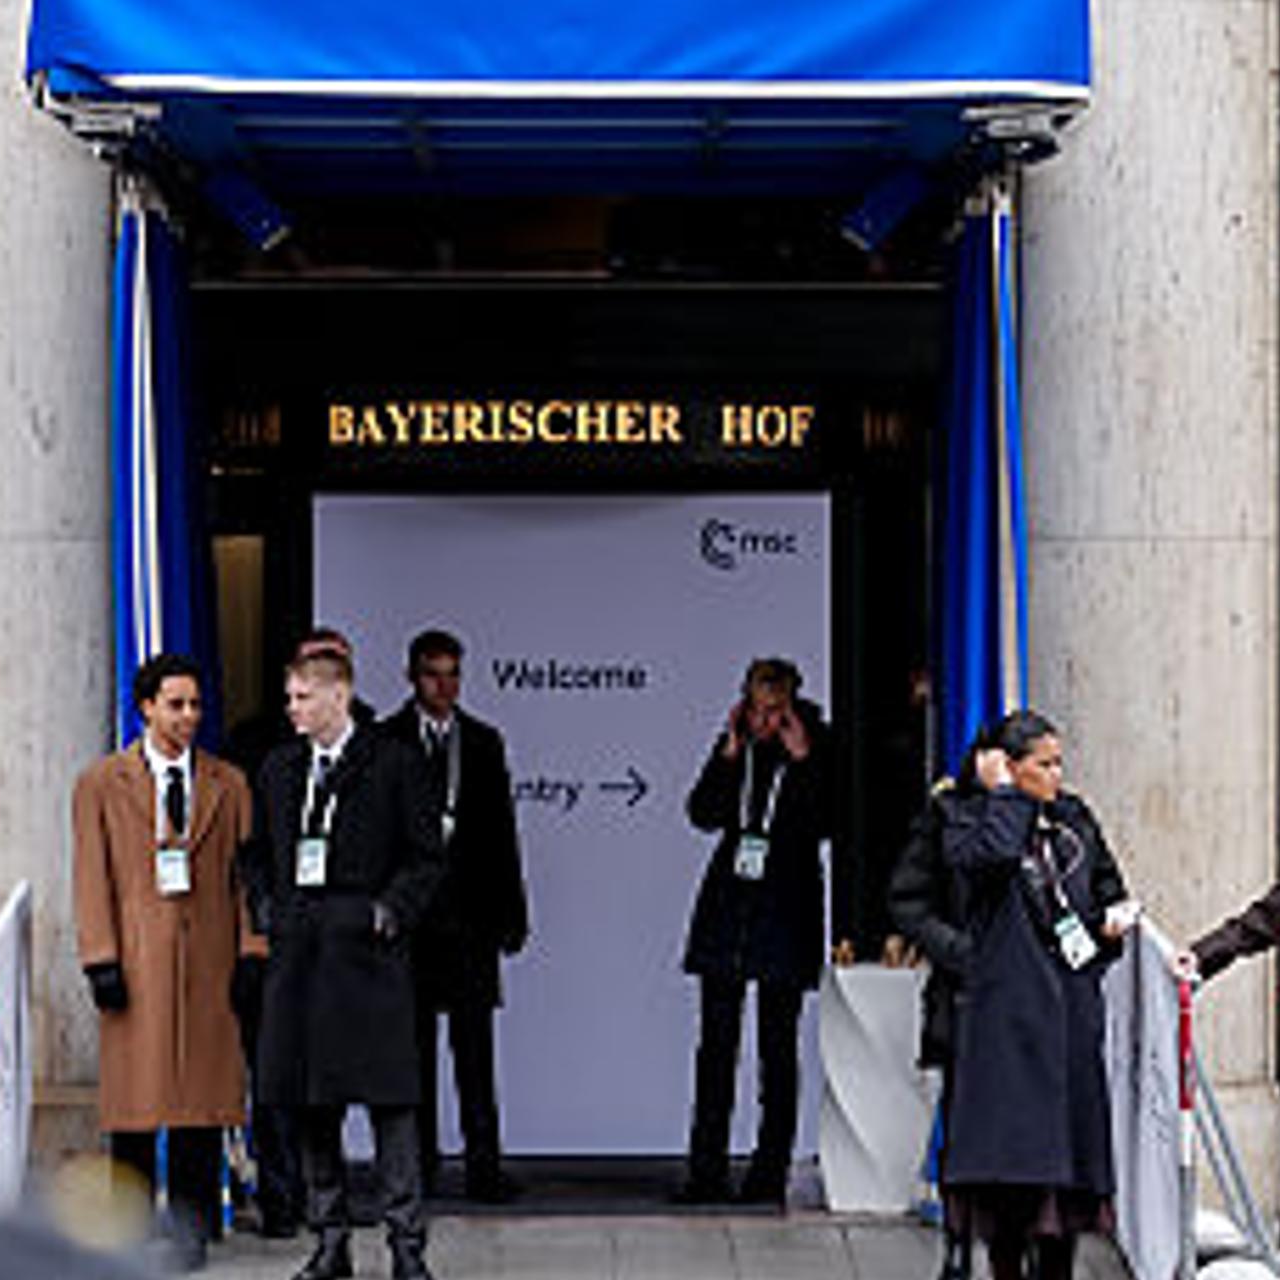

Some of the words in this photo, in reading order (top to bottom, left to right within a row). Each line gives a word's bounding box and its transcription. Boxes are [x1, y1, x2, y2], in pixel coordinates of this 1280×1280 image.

[327, 401, 684, 445] BAYERISCHER
[721, 404, 814, 447] HOF
[492, 658, 647, 690] Welcome
[515, 776, 584, 812] ntry
